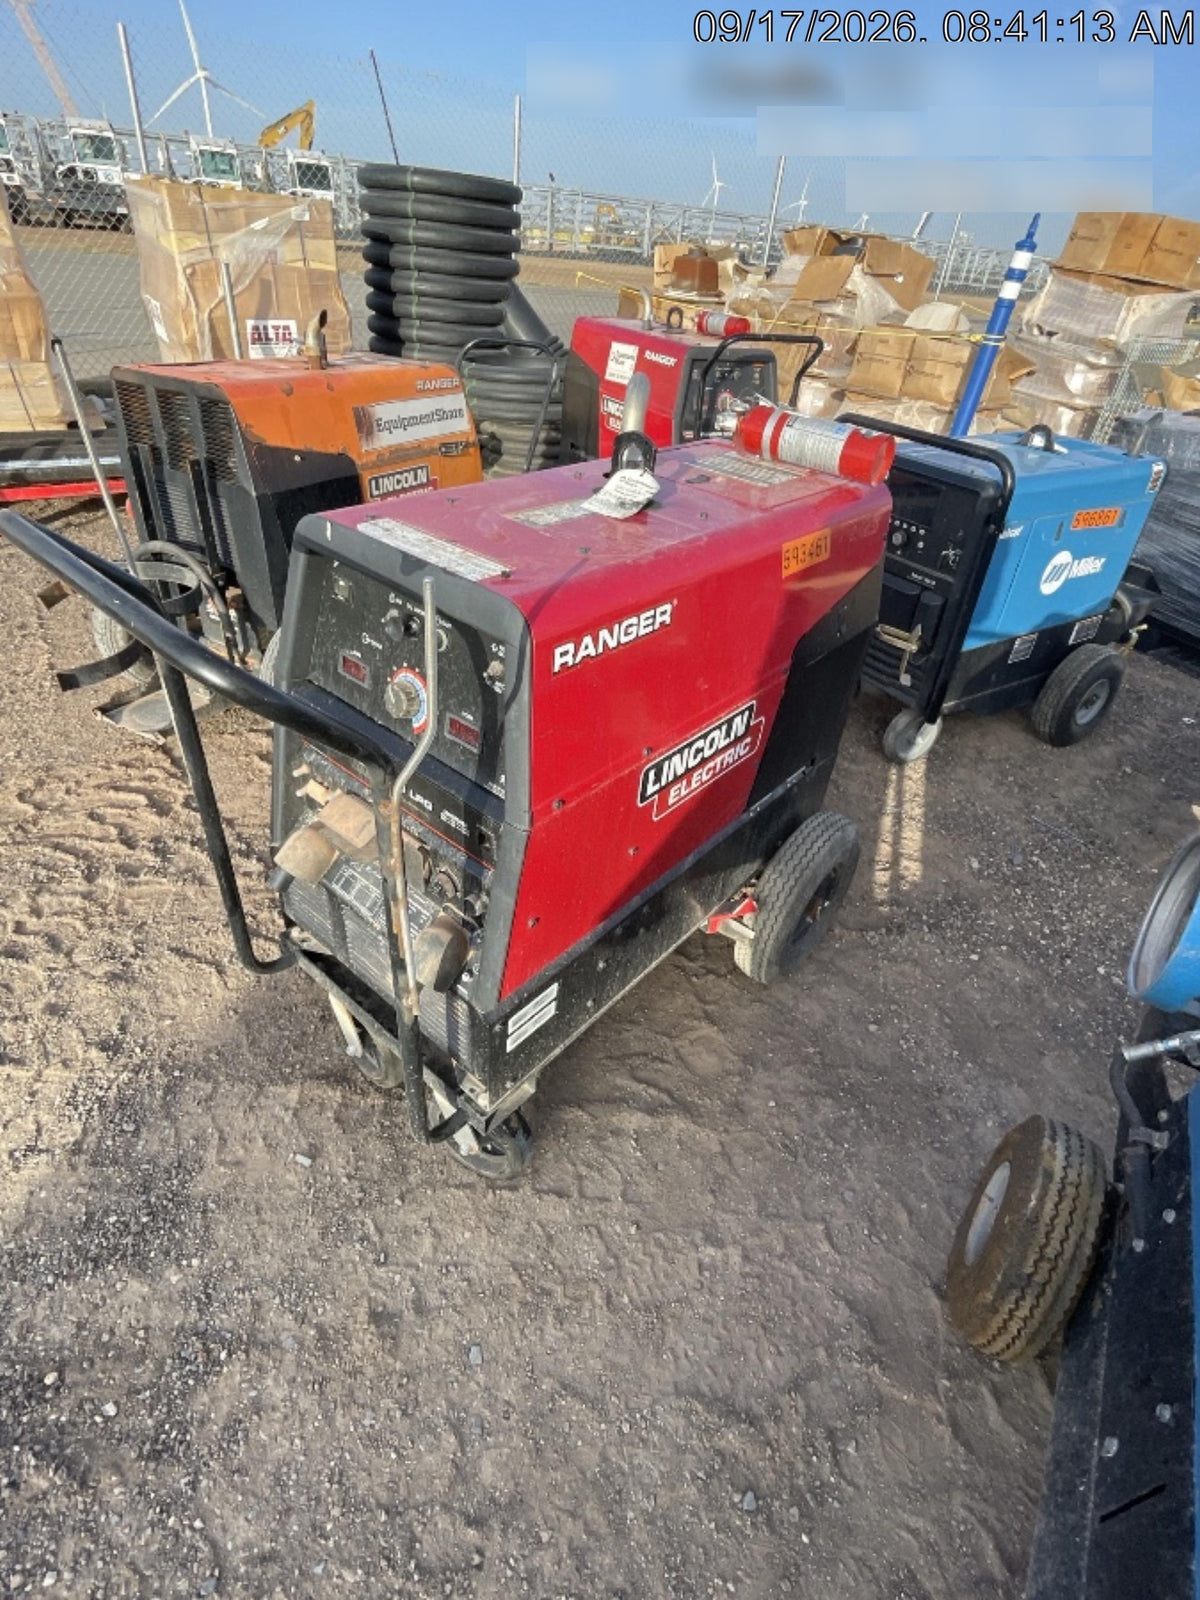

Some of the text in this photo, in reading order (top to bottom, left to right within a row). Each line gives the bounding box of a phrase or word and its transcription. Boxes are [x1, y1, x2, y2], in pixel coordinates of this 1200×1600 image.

[644, 349, 678, 367] RANGER
[416, 377, 460, 391] RANGER
[375, 408, 465, 434] EquipmentShare
[370, 467, 428, 496] LINCOLN
[783, 535, 828, 570] 593461
[1067, 556, 1107, 579] Miller
[552, 602, 673, 674] RANGER
[644, 709, 751, 797] LINCOLN
[667, 736, 752, 806] ELECTRIC
